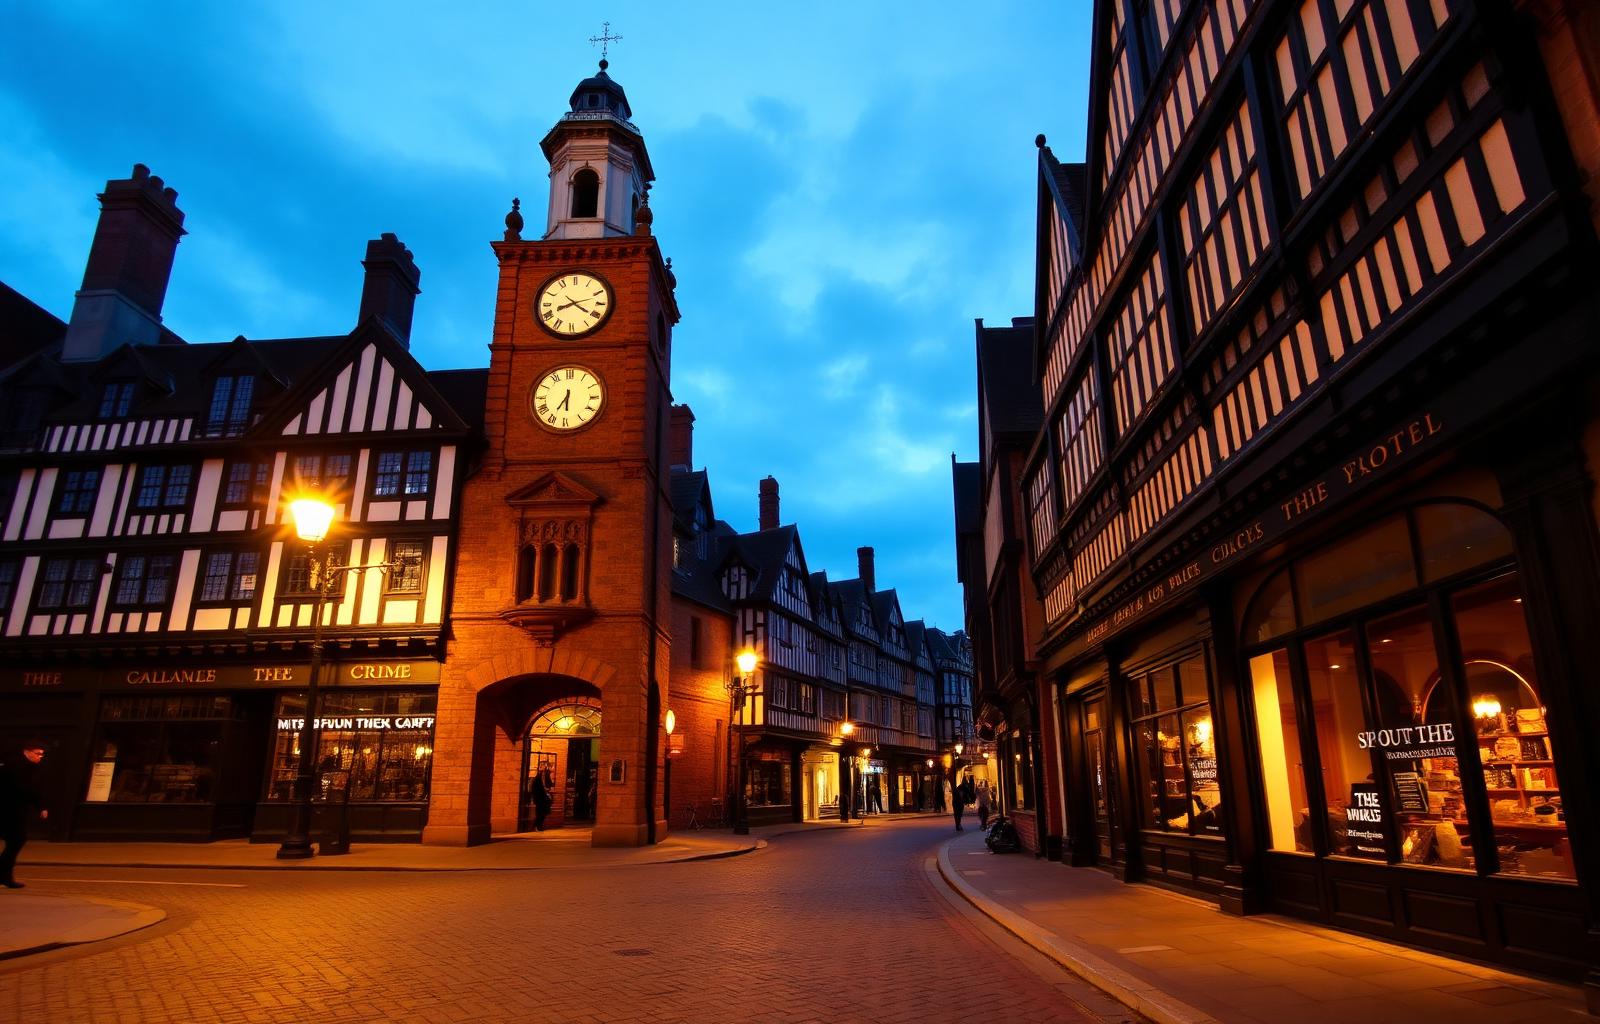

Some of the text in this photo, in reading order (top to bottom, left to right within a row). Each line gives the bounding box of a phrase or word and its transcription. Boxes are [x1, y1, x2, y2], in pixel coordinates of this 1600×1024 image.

[350, 664, 411, 680] CRIME
[1415, 723, 1455, 744] THE
[1353, 792, 1381, 807] THE
